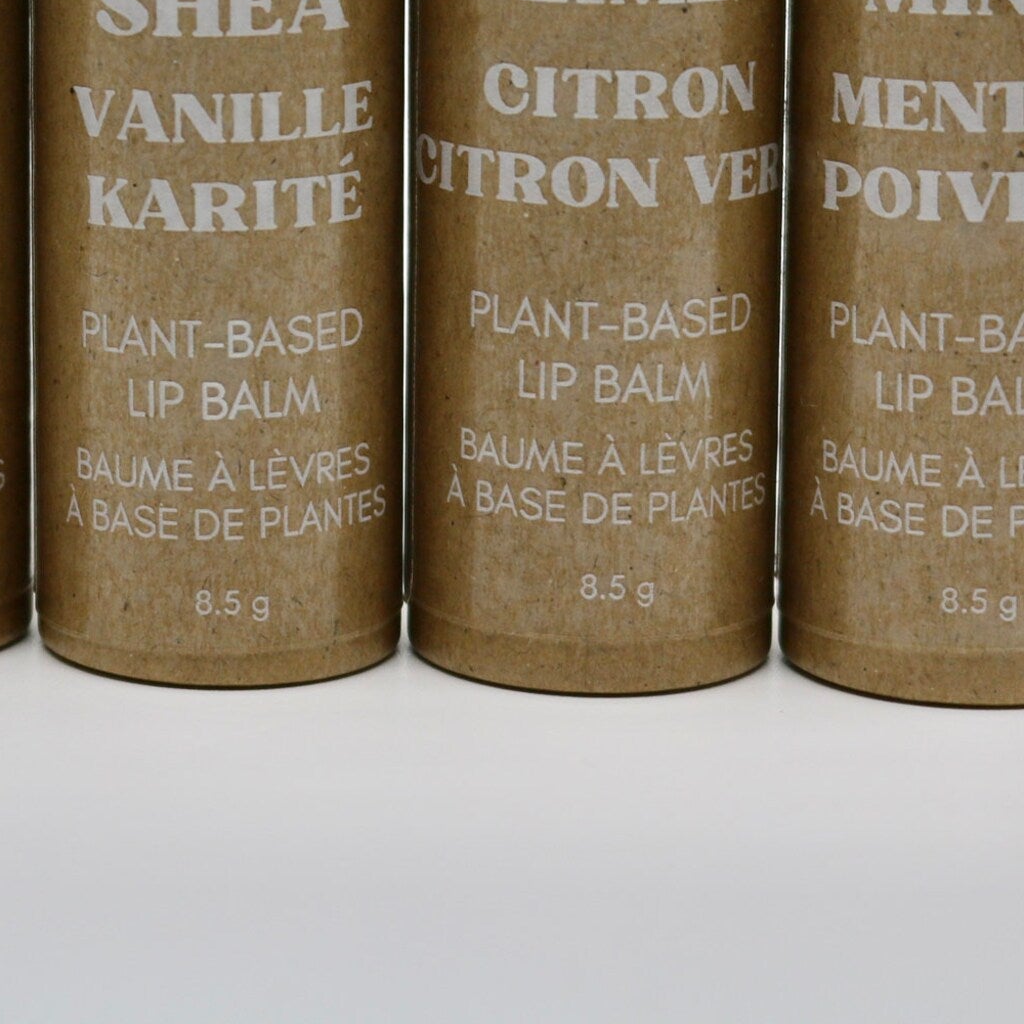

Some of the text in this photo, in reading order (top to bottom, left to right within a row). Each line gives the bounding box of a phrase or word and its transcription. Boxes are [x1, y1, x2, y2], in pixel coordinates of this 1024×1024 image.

[74, 81, 374, 143] VANILLE
[483, 63, 757, 120] CITRON
[87, 154, 364, 233] KARITÉ
[416, 132, 660, 208] CITRON
[81, 309, 363, 359] PLANT-BASED
[471, 287, 750, 341] PLANT-BASED
[128, 377, 322, 421] LIP BALM
[518, 360, 710, 403] LIP BALM
[875, 371, 933, 412] LIP
[77, 444, 370, 491] BAUME À LÈVRES
[461, 426, 753, 475] BAUME À LÈVRES
[822, 441, 943, 490] BAUME
[956, 447, 985, 488] À
[67, 484, 386, 541] À BASE DE PLANTES
[446, 464, 766, 525] À BASE DE PLANTES
[810, 476, 828, 520] À
[838, 493, 925, 536] BASE
[942, 505, 992, 538] DE
[195, 590, 270, 621] 8.5 g
[580, 574, 655, 607] 8.5 g
[941, 587, 1018, 621] 8.5 g
